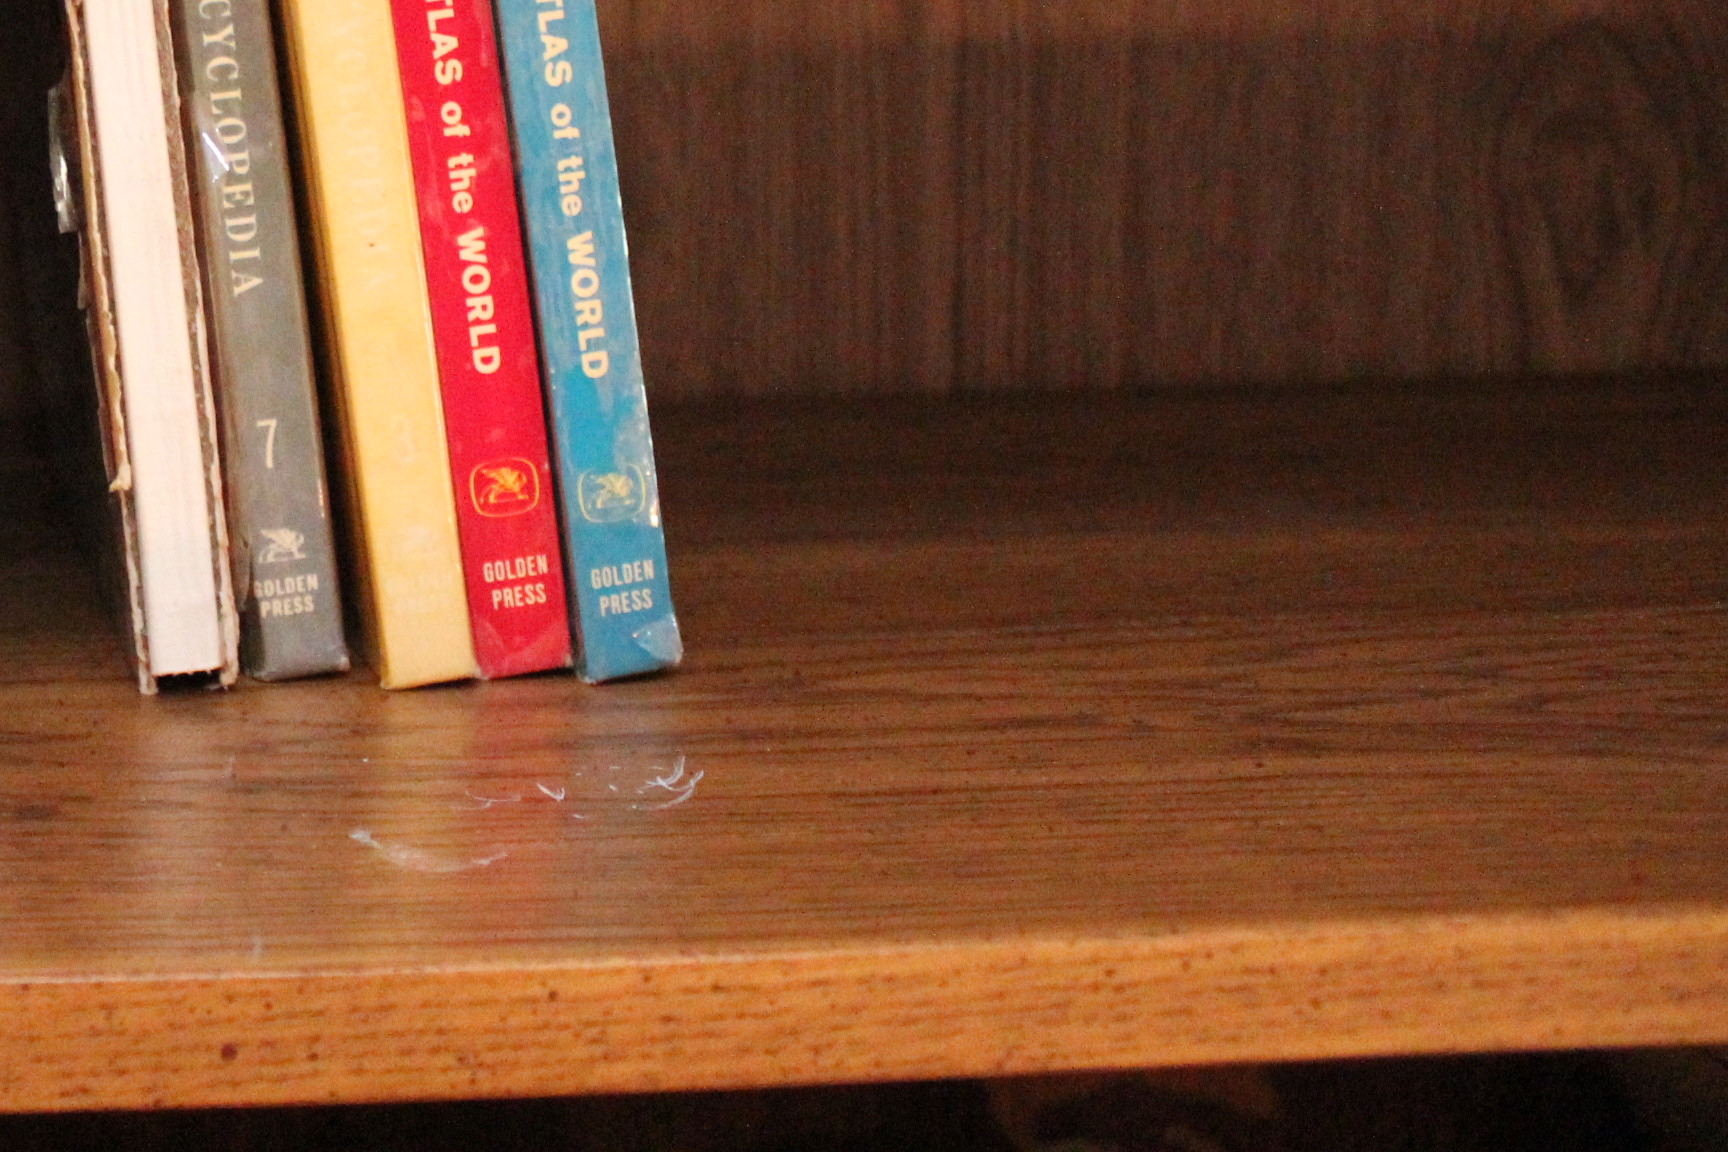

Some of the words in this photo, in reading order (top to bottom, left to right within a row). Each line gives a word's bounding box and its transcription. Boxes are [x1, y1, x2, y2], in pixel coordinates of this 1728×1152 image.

[440, 101, 471, 138] of
[550, 103, 581, 140] of
[448, 152, 476, 214] the
[557, 154, 586, 217] the
[457, 226, 501, 375] WORLD
[567, 230, 609, 379] WORLD
[257, 418, 277, 469] 7
[254, 574, 319, 598] GOLDEN
[483, 554, 548, 583] GOLDEN
[590, 559, 654, 589] GOLDEN
[260, 595, 315, 618] PRESS
[492, 583, 546, 610] PRESS
[599, 589, 653, 617] PRESS
